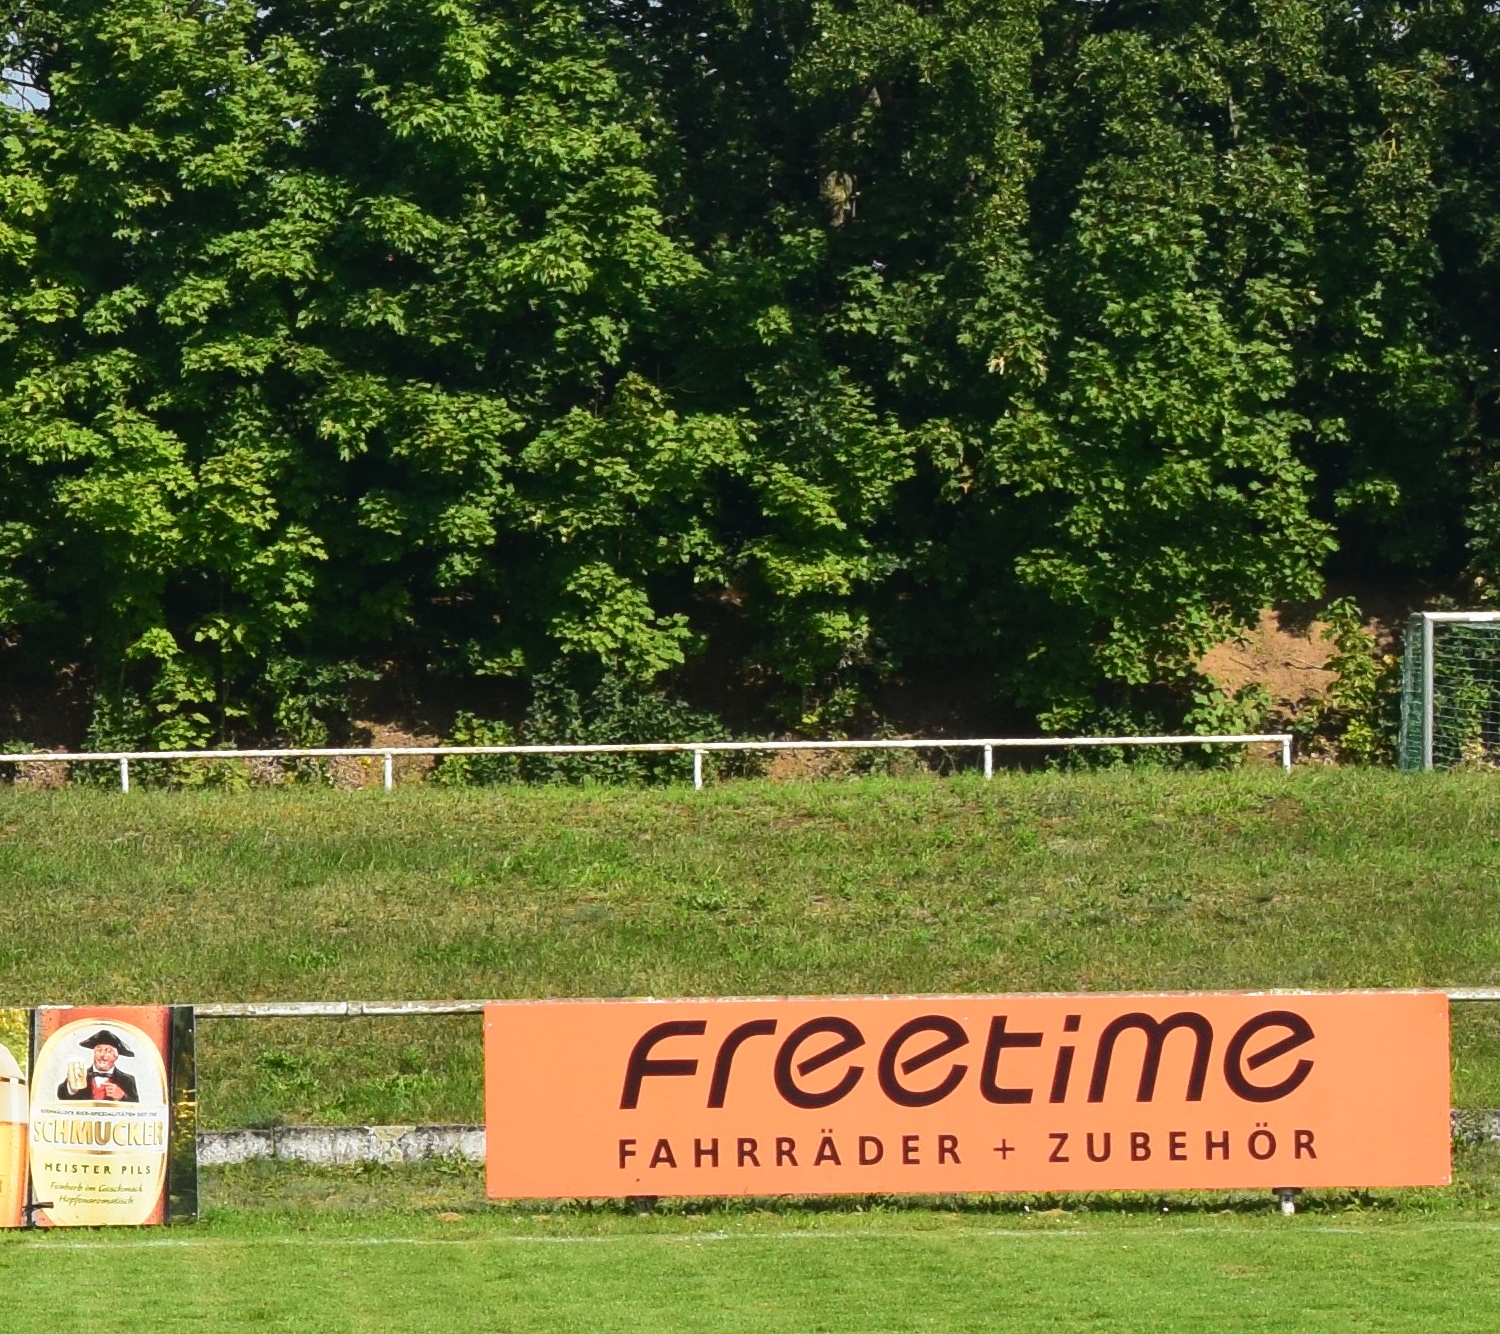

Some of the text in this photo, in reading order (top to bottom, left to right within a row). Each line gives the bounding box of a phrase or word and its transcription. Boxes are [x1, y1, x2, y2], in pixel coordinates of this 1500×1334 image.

[33, 1119, 164, 1146] SCHMUCKER
[618, 1122, 1317, 1169] FAHRRÄDER + ZUBEHÖR
[44, 1163, 151, 1174] MEISTER PILS
